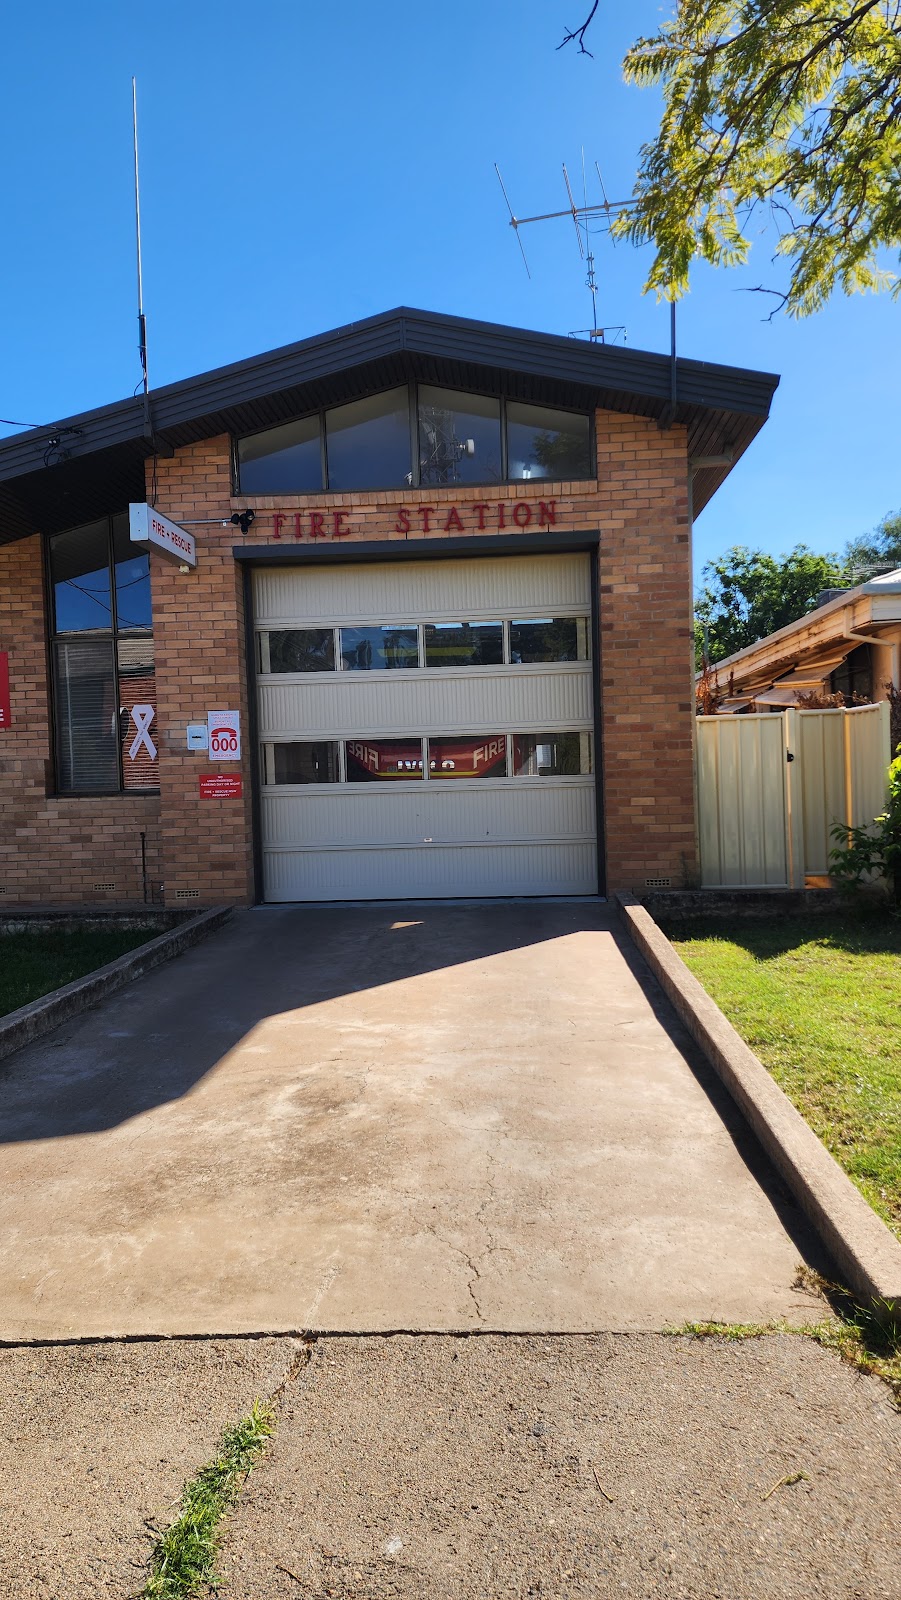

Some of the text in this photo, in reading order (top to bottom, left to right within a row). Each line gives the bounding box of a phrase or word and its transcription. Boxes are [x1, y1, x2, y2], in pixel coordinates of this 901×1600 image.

[272, 500, 556, 538] FIRE STATION
[152, 519, 165, 538] FIRE
[171, 531, 191, 555] RESCUE
[211, 737, 238, 752] 000
[473, 736, 504, 769] FIRE
[398, 759, 455, 770] IVO
